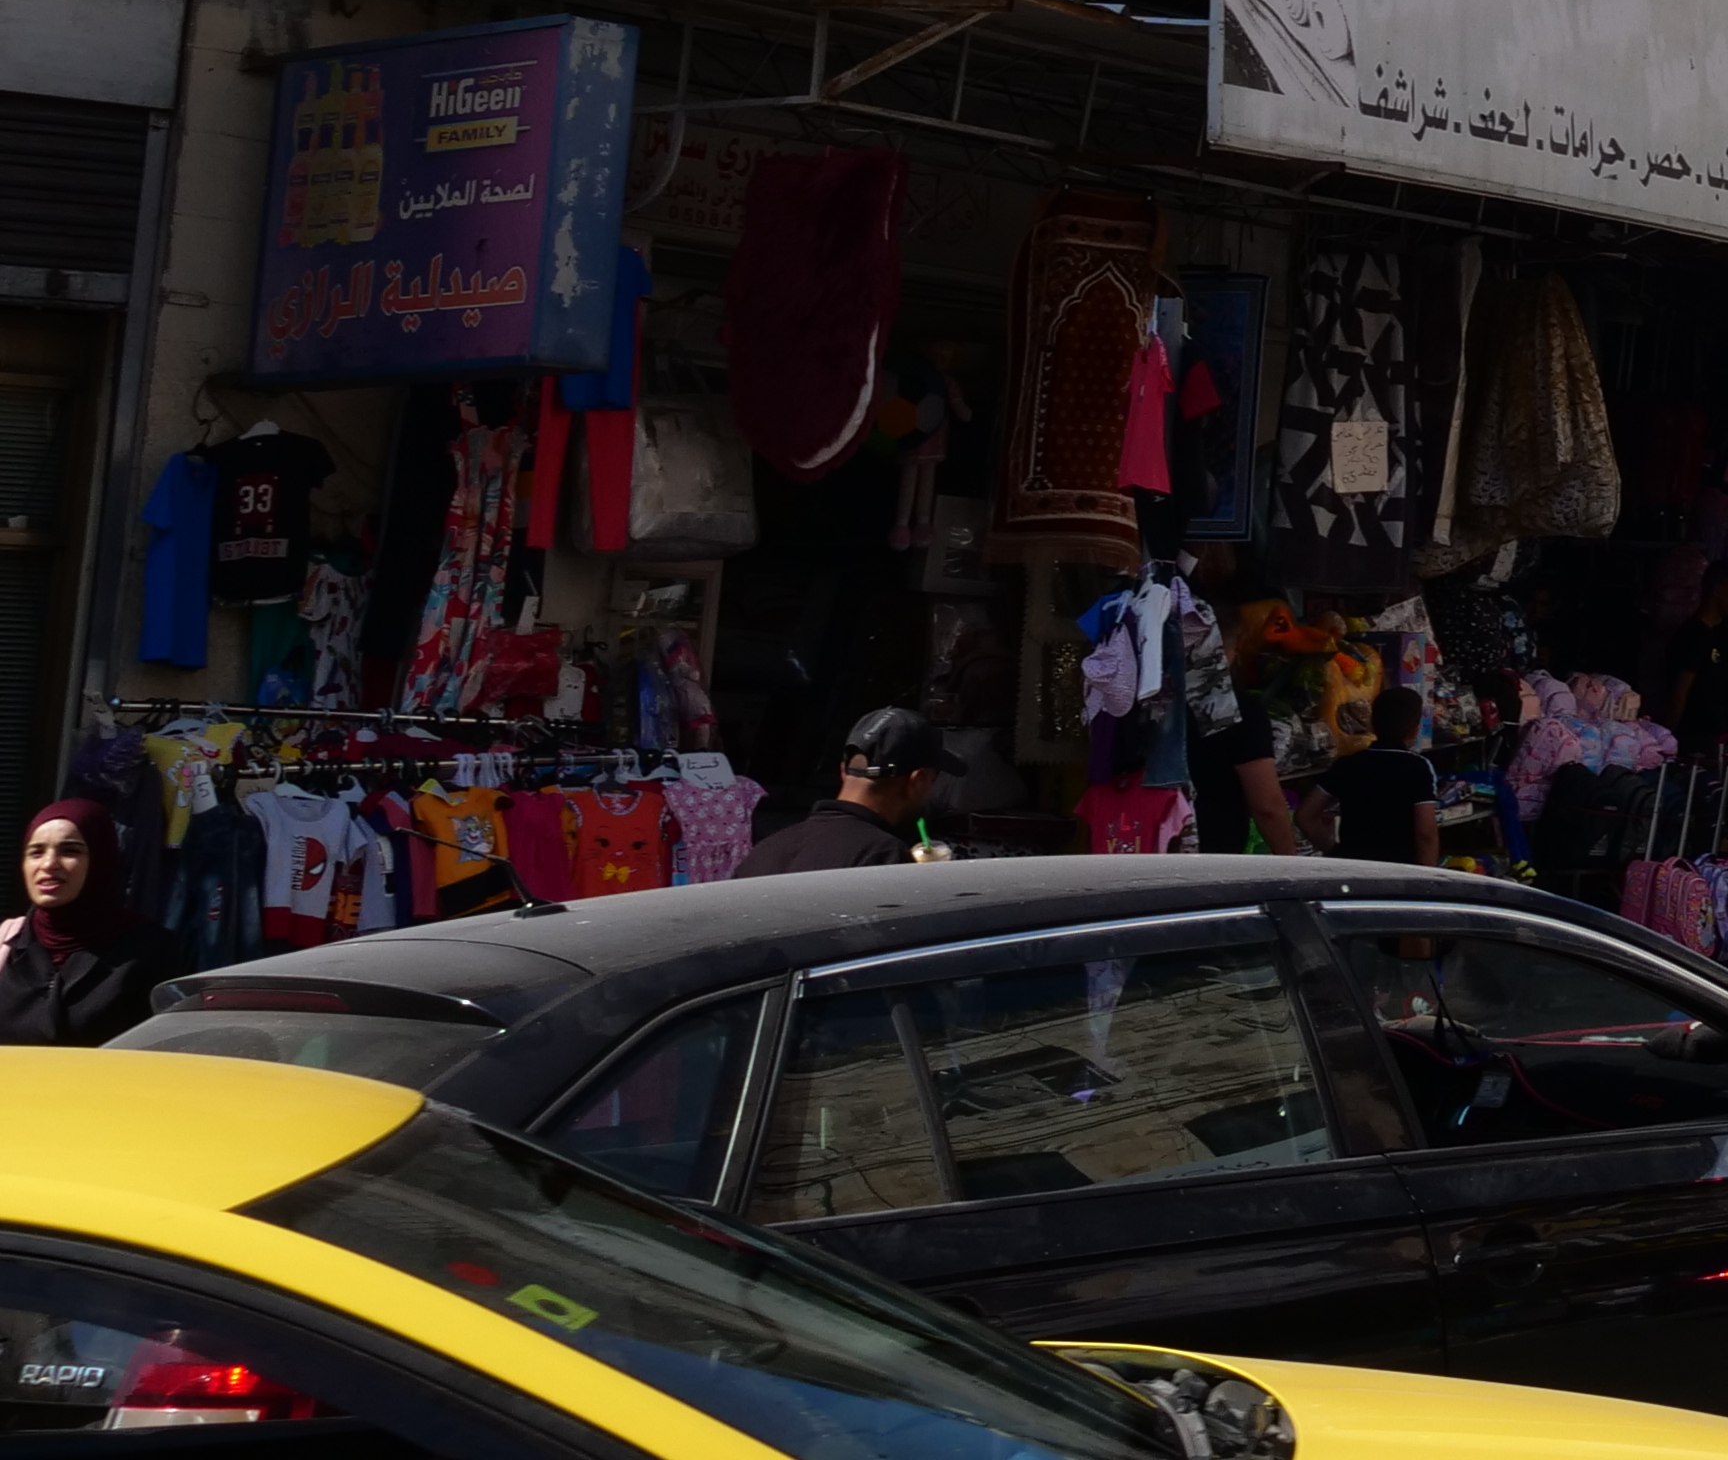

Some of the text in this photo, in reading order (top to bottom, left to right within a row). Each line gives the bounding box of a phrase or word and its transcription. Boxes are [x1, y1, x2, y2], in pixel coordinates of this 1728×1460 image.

[428, 76, 523, 118] HiGeen
[1358, 63, 1449, 142] شراشف
[436, 123, 508, 145] FAMILY
[267, 252, 528, 359] صيدلية الرازي
[239, 483, 274, 514] 33
[17, 1363, 106, 1389] RAPID
